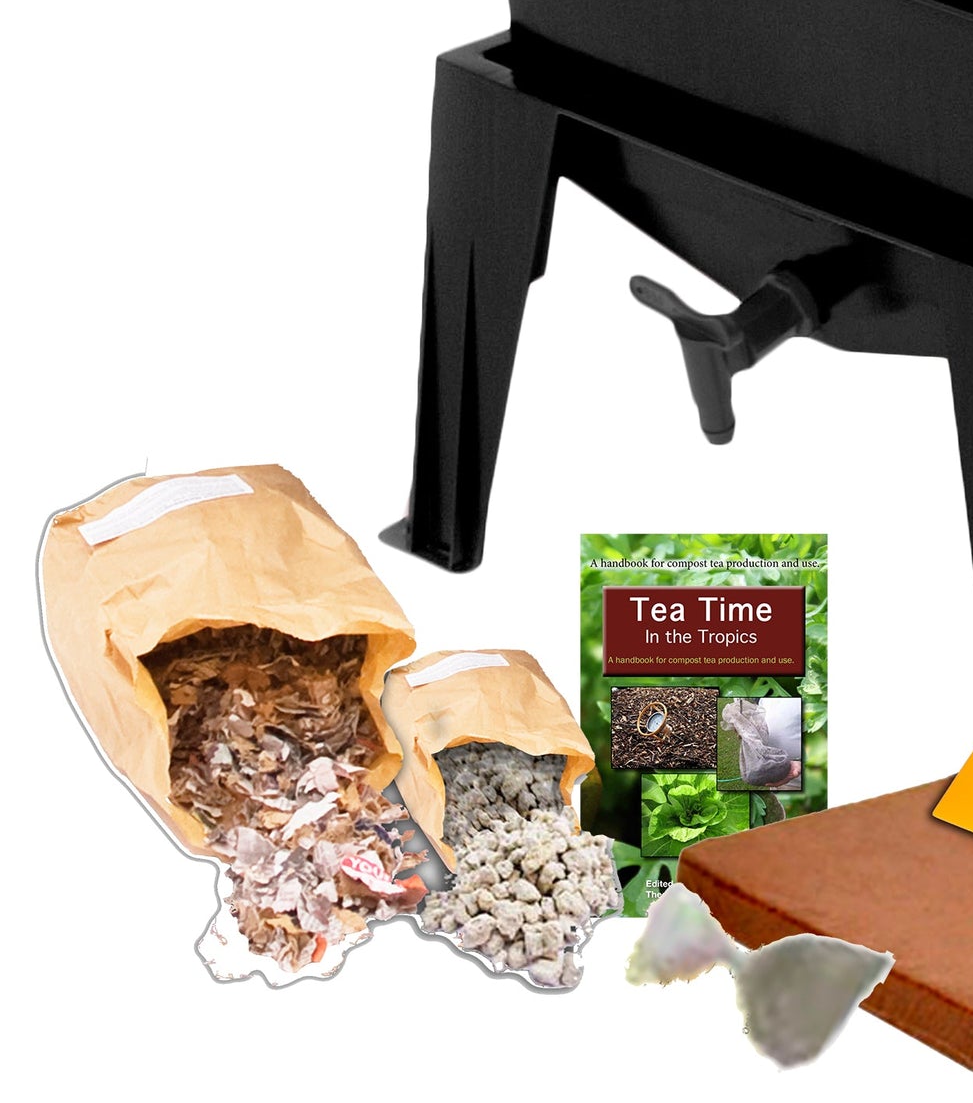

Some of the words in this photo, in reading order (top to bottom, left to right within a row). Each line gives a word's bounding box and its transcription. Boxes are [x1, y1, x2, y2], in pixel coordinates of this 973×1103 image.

[590, 559, 598, 568] A
[600, 558, 648, 568] handbook
[651, 558, 665, 568] for
[667, 559, 707, 571] compost
[710, 560, 724, 568] tea
[726, 558, 779, 571] production
[781, 558, 799, 568] and
[629, 596, 685, 622] Tea
[698, 596, 772, 622] Time
[645, 630, 659, 644] In
[665, 629, 692, 644] the
[697, 629, 758, 647] Tropics
[608, 656, 614, 664] A
[615, 656, 654, 664] handbook
[655, 656, 666, 664] for
[668, 657, 701, 666] compost
[718, 656, 759, 666] production
[761, 656, 777, 664] and
[646, 880, 674, 888] Edited
